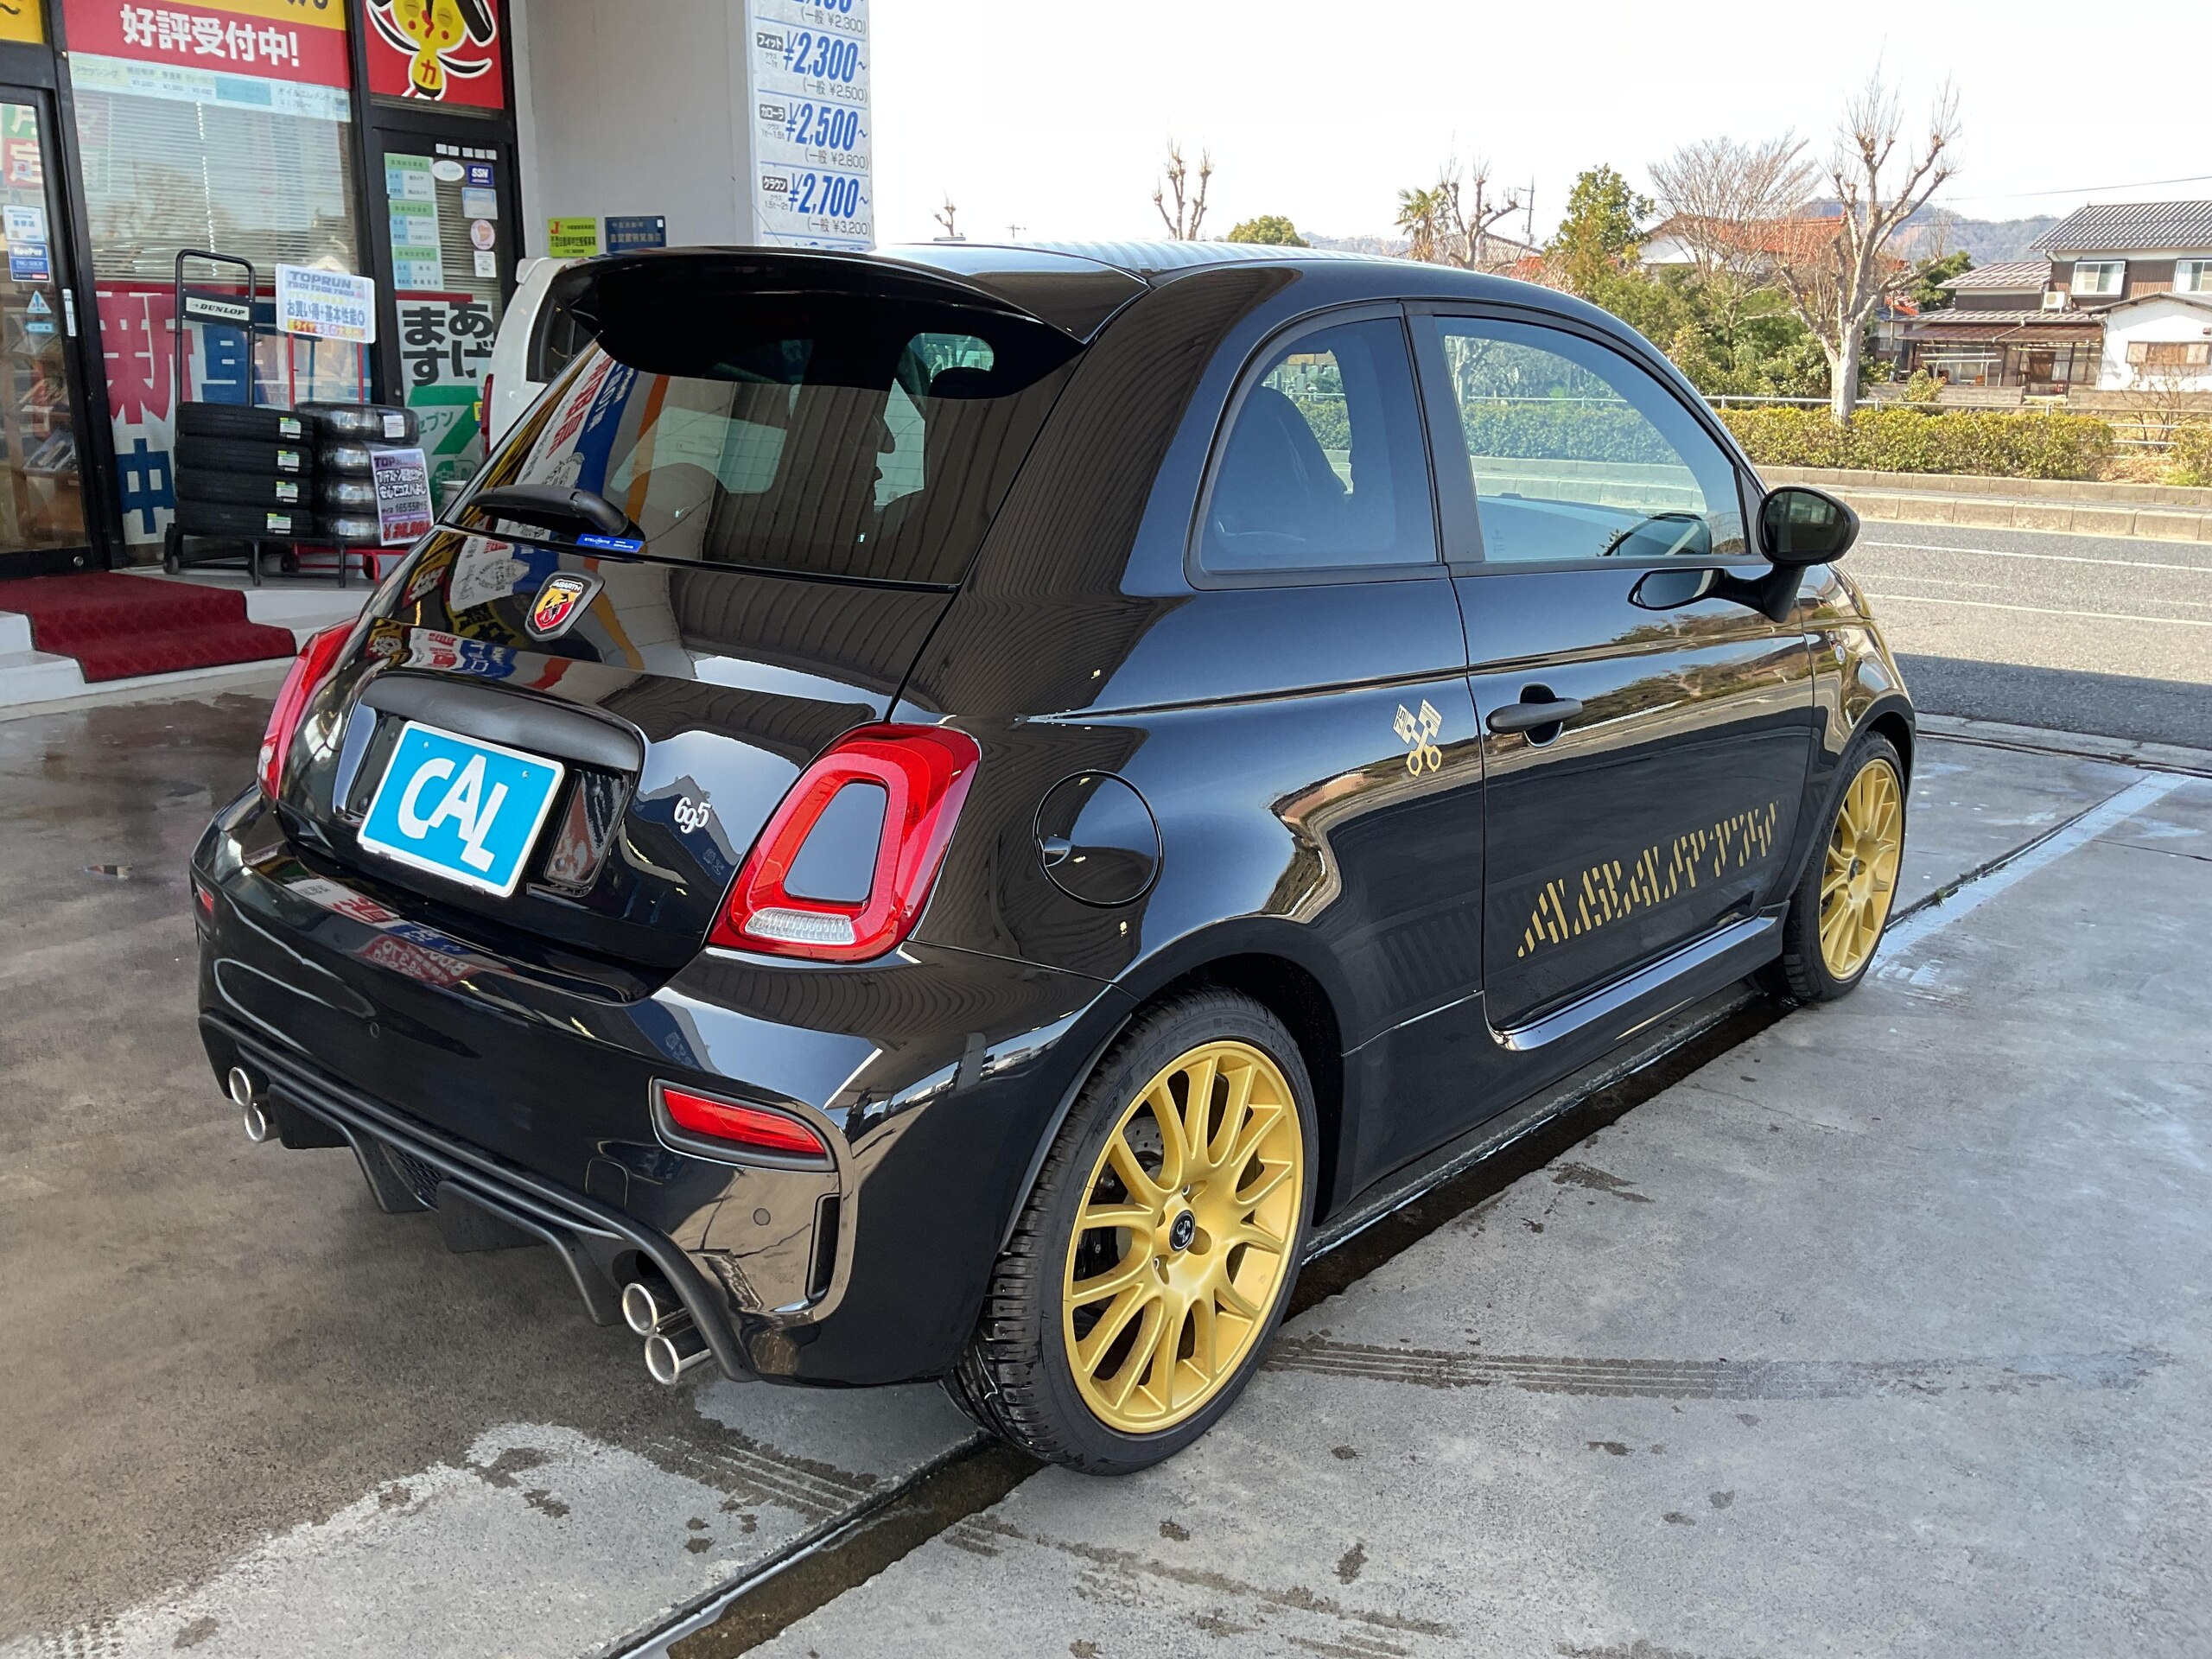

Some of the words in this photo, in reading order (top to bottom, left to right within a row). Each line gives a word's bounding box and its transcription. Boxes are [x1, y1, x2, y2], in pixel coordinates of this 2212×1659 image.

[758, 35, 782, 49] フィット
[760, 105, 785, 120] カローラ
[289, 270, 352, 289] TOPRUN
[200, 303, 245, 315] DUNLOP
[553, 582, 582, 592] ABARTH
[397, 753, 509, 873] CAL
[674, 796, 712, 834] 695
